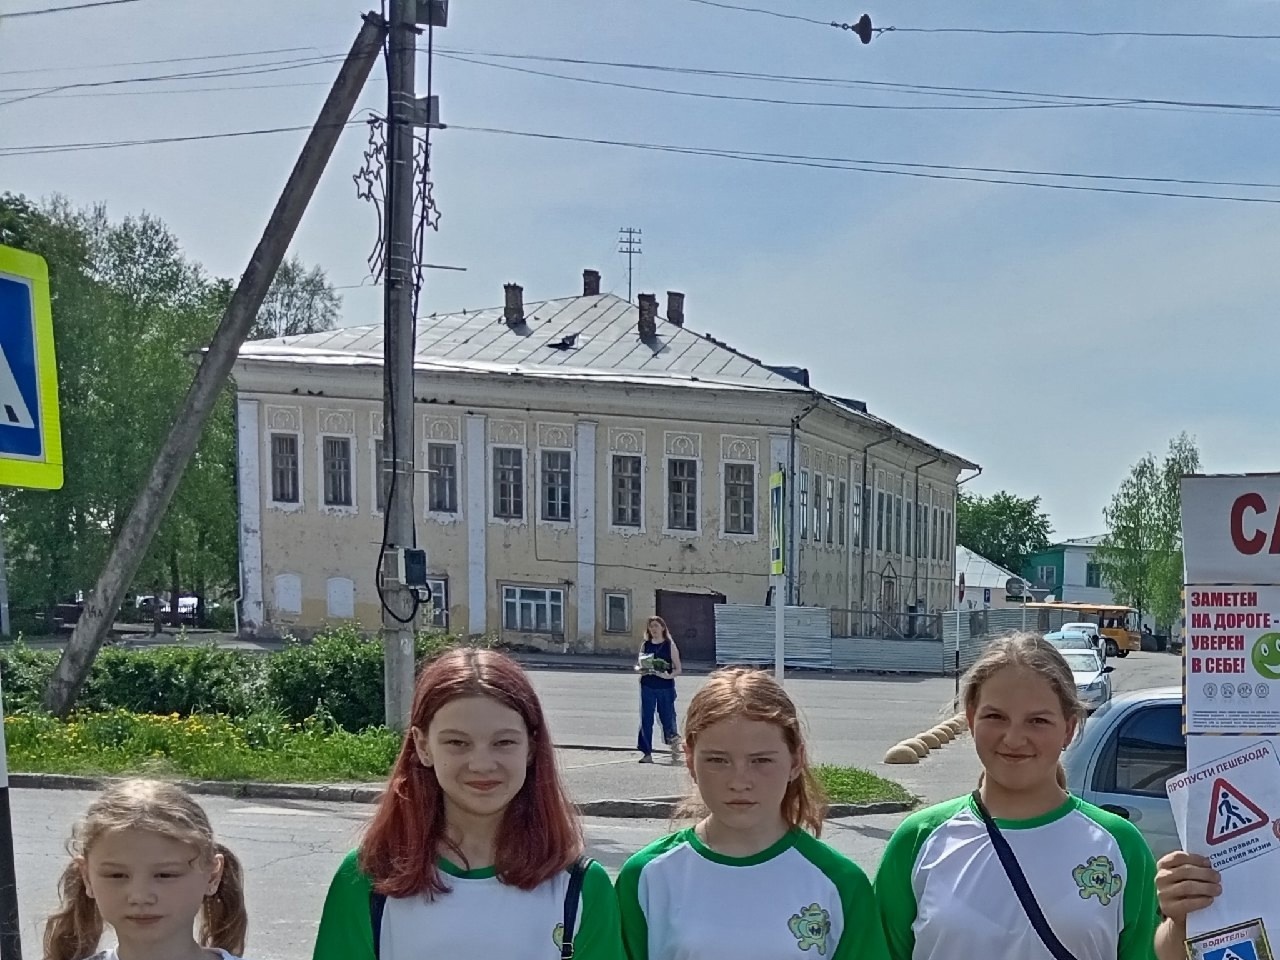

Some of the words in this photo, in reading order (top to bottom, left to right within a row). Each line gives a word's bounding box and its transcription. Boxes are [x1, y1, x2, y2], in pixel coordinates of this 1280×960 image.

[1191, 592, 1257, 607] ЗАМЕТЕН
[1191, 613, 1212, 629] НА
[1214, 613, 1271, 631] ДОРОГЕ
[1191, 635, 1245, 651] УВЕРЕН
[1191, 657, 1202, 674] В
[1205, 657, 1246, 674] СЕБЕ!
[1167, 768, 1216, 794] ПРОПУСТИ
[1216, 746, 1270, 774] ПЕШЕХОДА
[1202, 931, 1248, 949] ВОДИТЕЛЬ!
